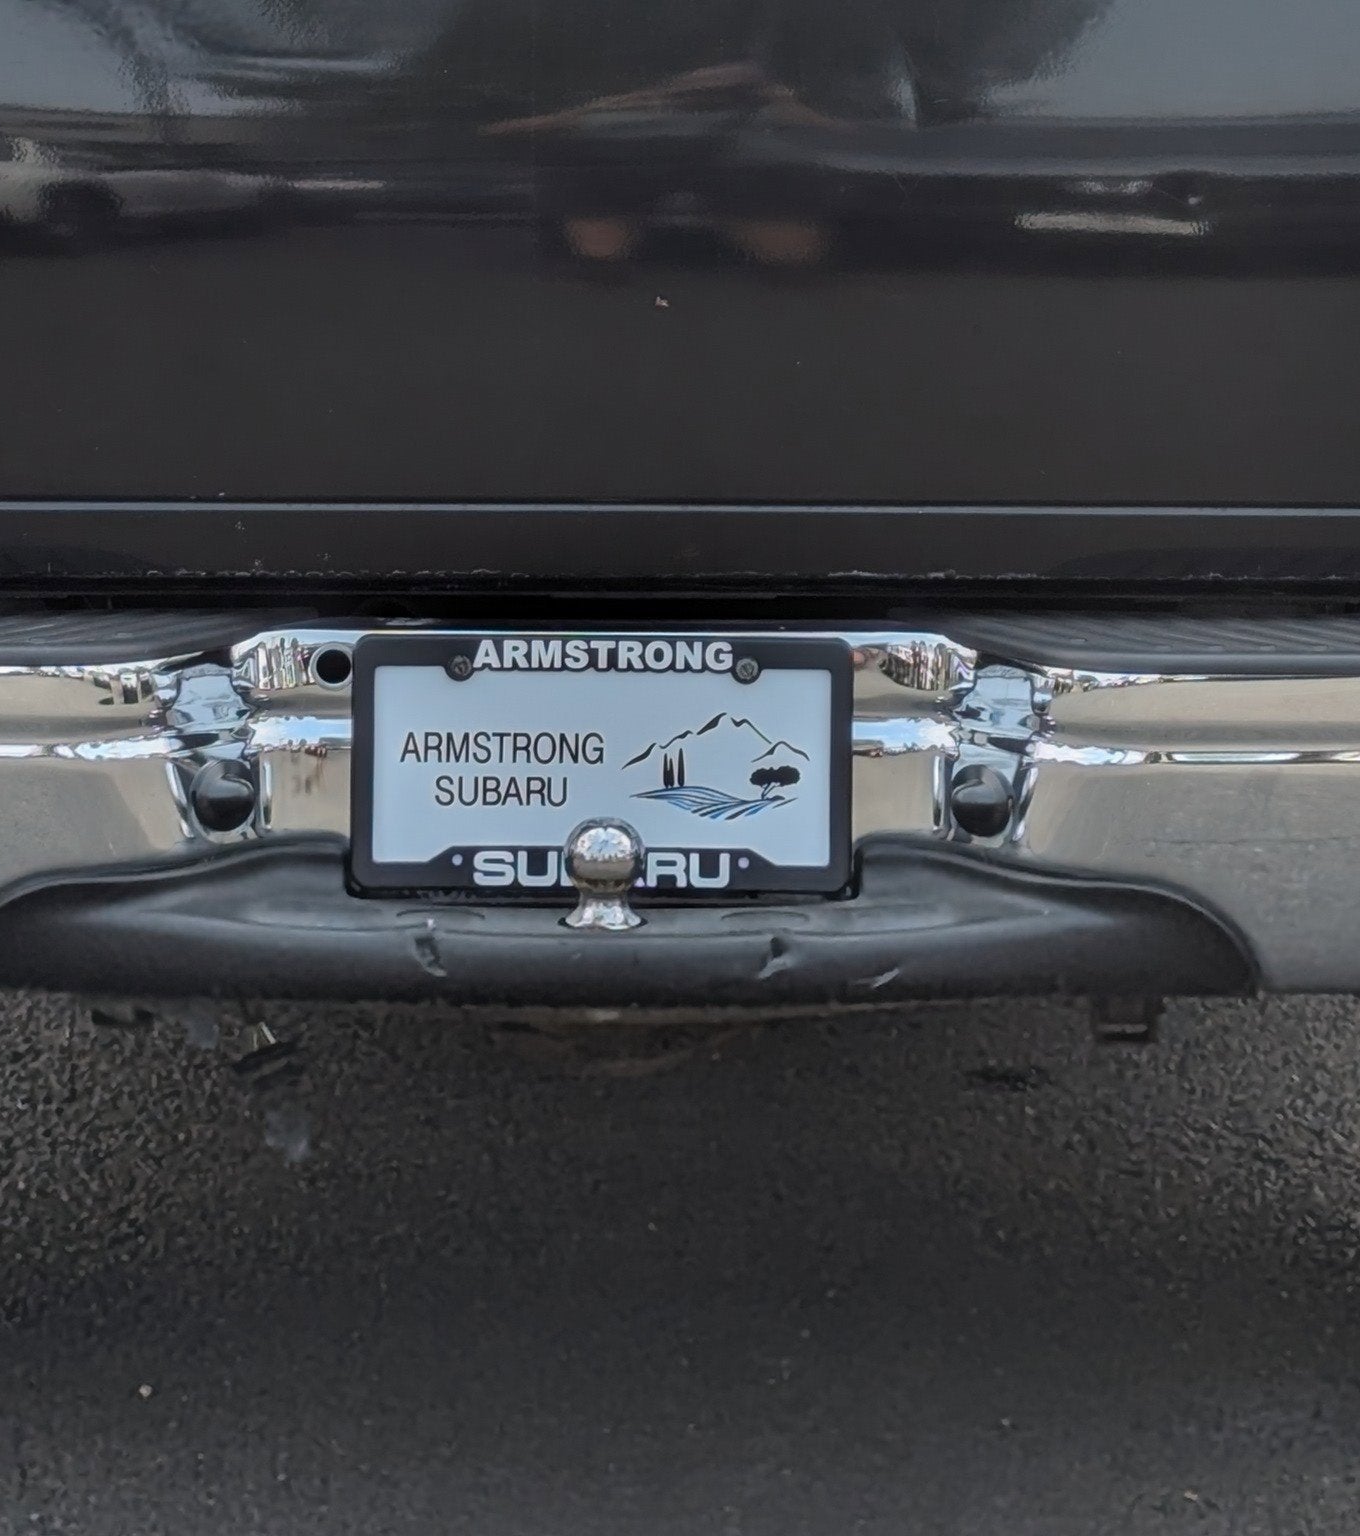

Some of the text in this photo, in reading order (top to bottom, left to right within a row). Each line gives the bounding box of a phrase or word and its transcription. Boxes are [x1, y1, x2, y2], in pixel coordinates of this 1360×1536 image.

[472, 639, 734, 670] ARMSTRONG
[400, 732, 605, 764] ARMSTRONG
[434, 775, 568, 807] SUBARU
[473, 850, 731, 888] SURU
